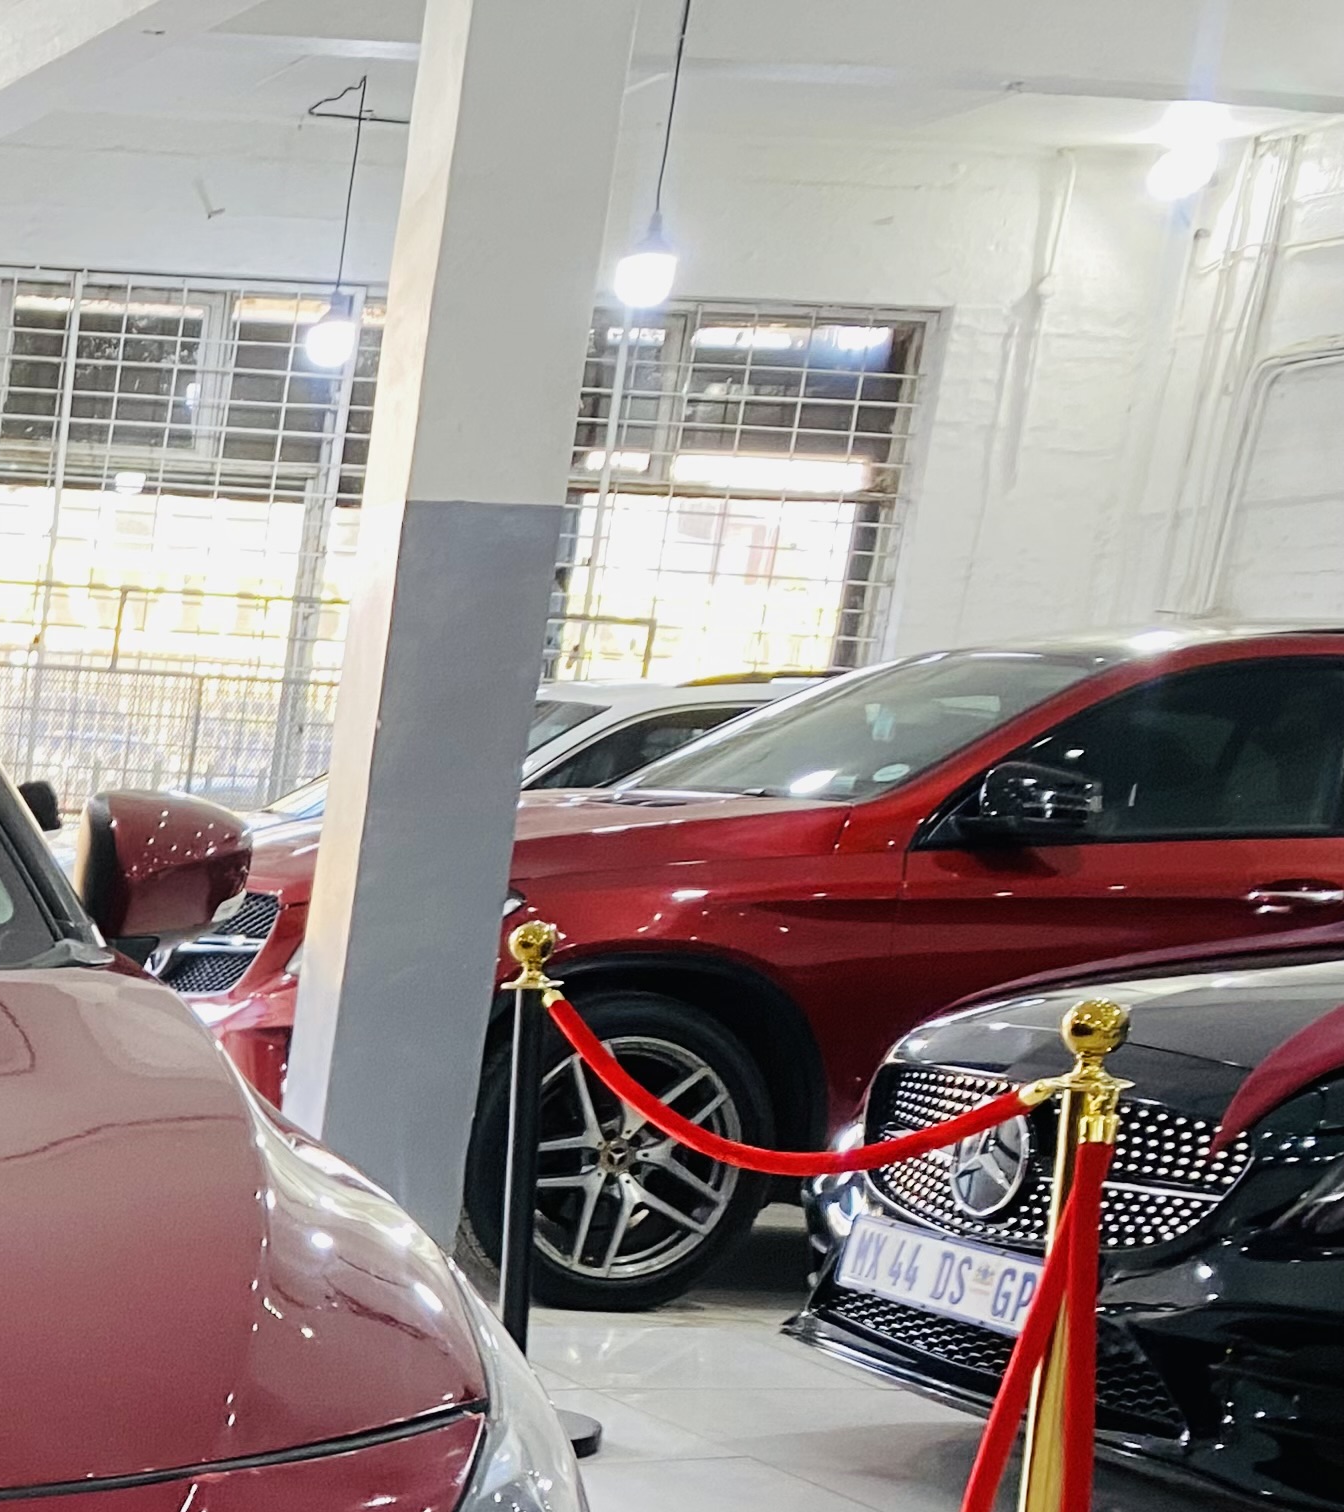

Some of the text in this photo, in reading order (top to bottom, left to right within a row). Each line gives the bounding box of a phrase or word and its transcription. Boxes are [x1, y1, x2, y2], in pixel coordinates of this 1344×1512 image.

[888, 1240, 923, 1292] 44
[929, 1251, 973, 1305] DS
[991, 1267, 1038, 1322] GP
